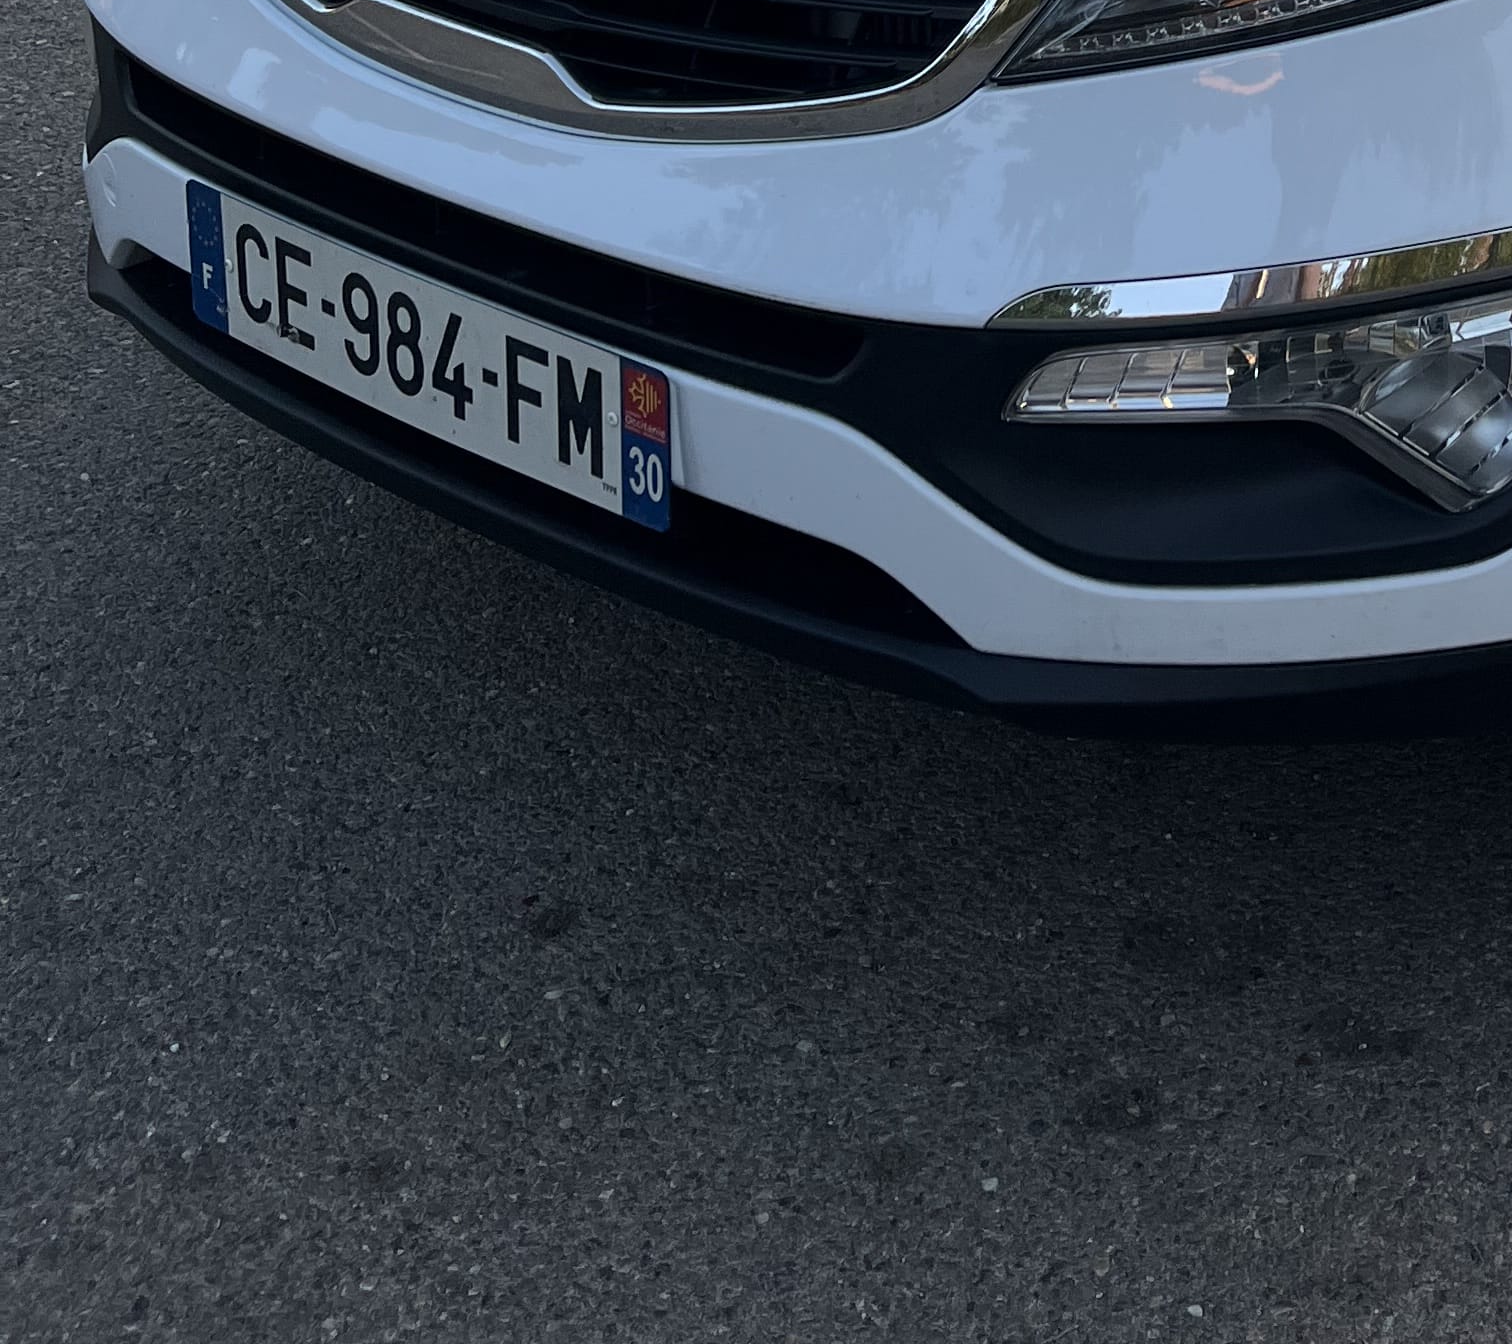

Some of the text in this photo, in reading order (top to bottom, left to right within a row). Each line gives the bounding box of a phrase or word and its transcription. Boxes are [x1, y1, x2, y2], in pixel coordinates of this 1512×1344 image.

[202, 262, 213, 290] F
[236, 223, 603, 479] CE-984-FM
[629, 446, 663, 503] 30
